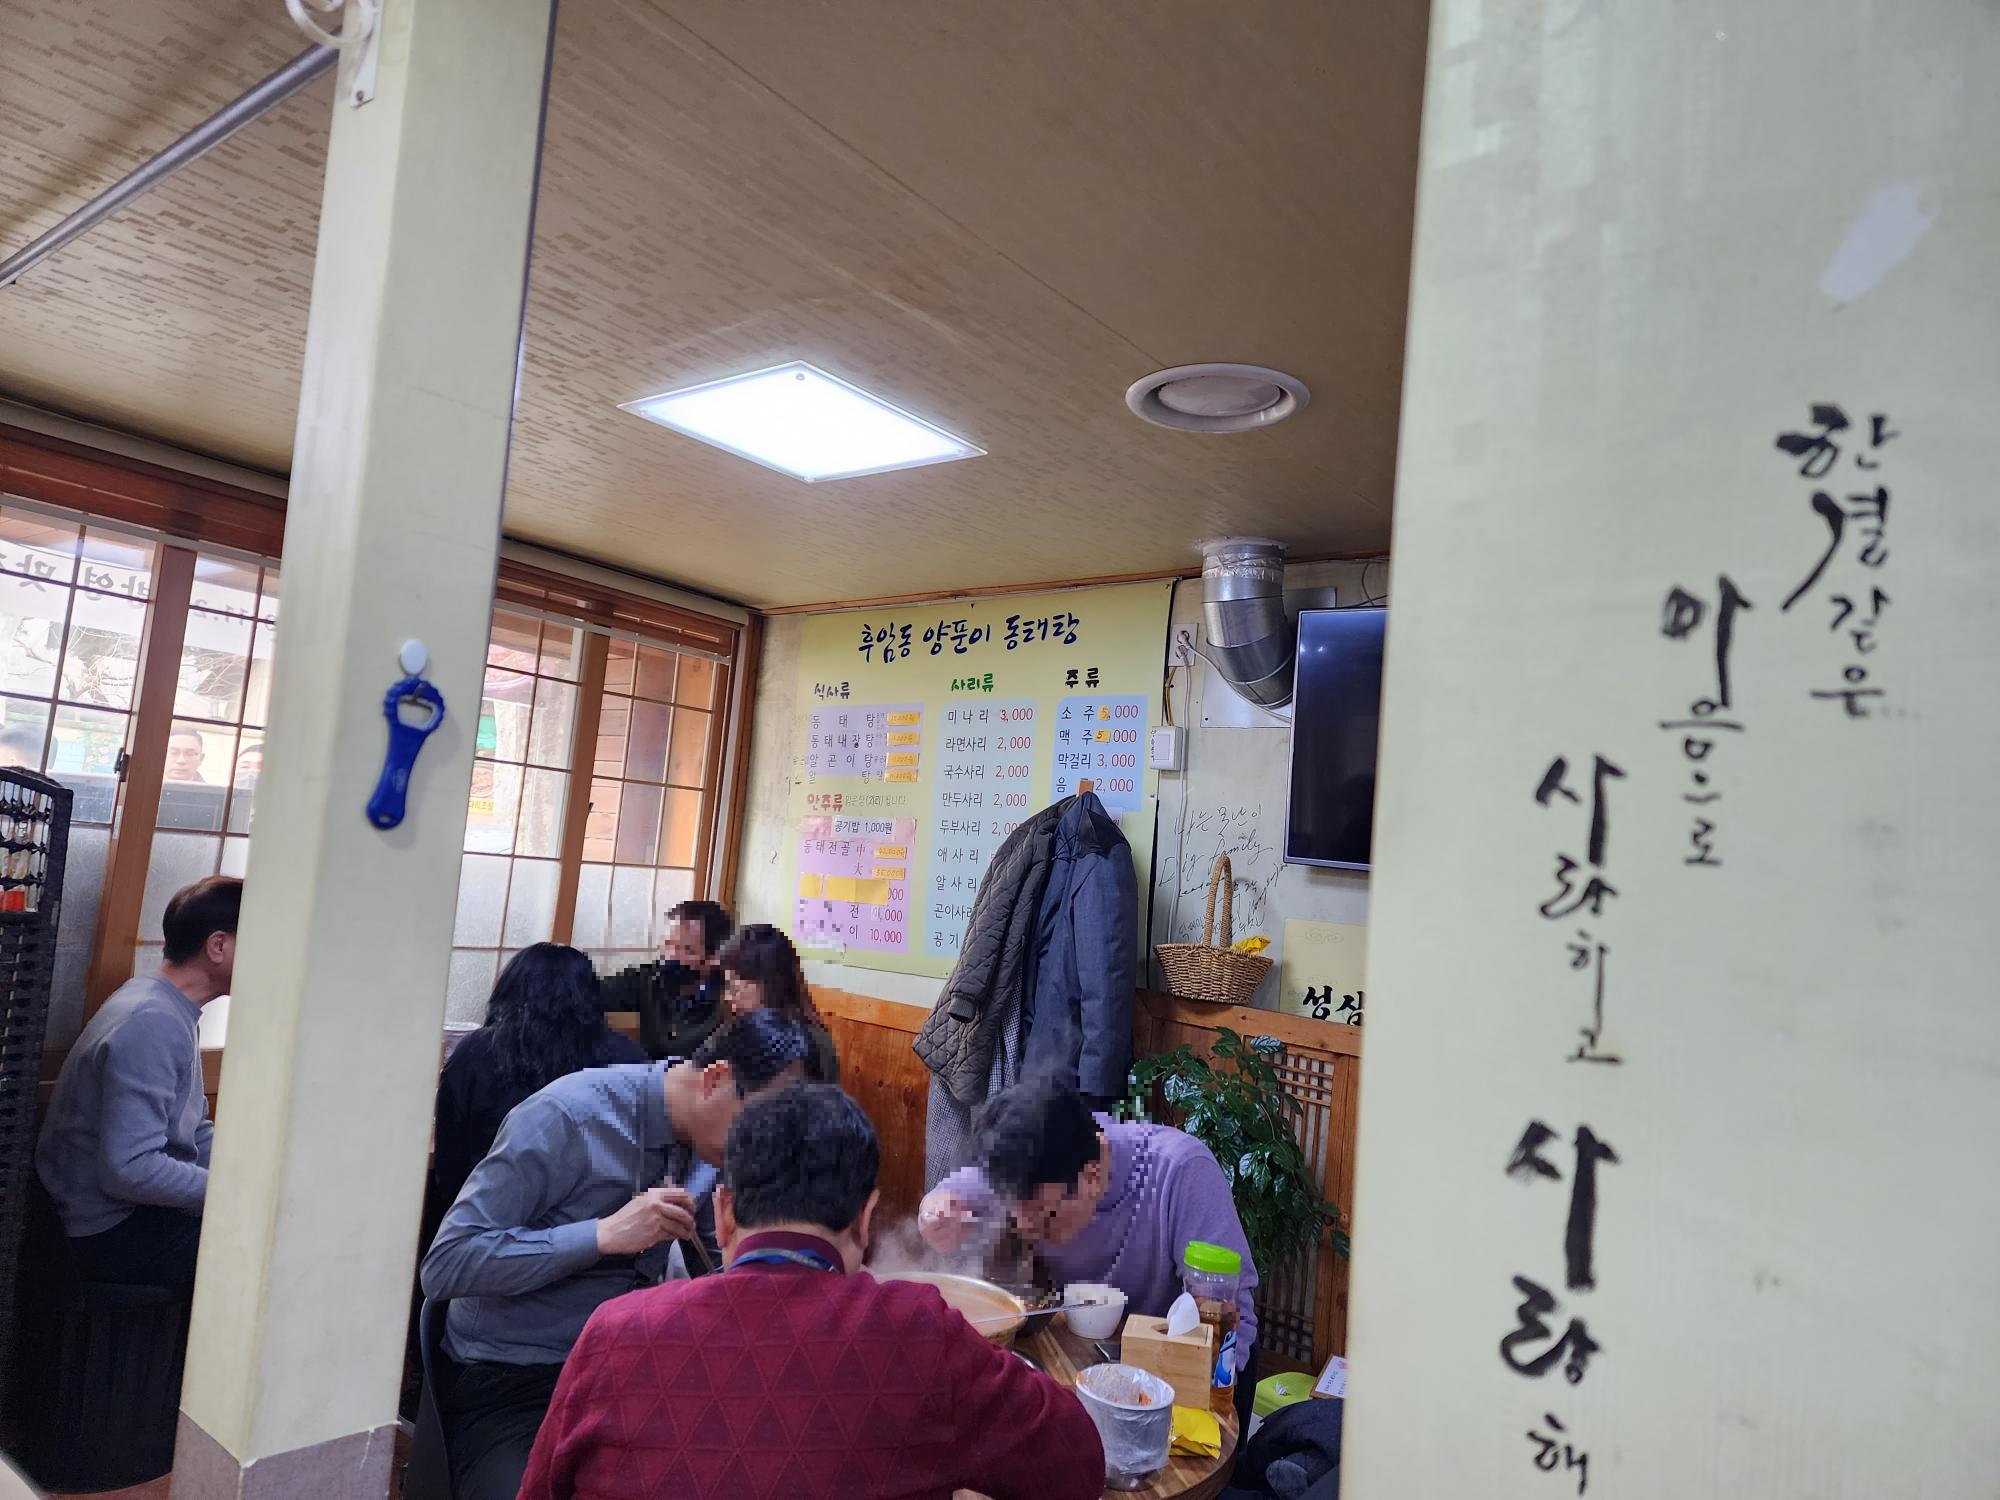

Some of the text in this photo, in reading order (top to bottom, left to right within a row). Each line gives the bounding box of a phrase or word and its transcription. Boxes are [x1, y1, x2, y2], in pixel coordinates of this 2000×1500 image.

[1776, 404, 1899, 718] 한결같은
[858, 612, 1080, 663] 후암동 양푼이 동태탕
[951, 673, 994, 692] 사리류
[1065, 667, 1100, 688] 주류
[814, 681, 850, 701] 식사류
[1000, 707, 1033, 722] 3,000
[1658, 573, 1753, 867] 마음으로
[945, 736, 1031, 752] 라면사리 2,000
[1058, 753, 1136, 769] 막걸리 3,000
[944, 764, 1029, 780] 국수사리 2,000
[1095, 778, 1134, 793] 2,000
[807, 793, 842, 812] 안주류
[942, 791, 1027, 808] 만두사리 2,000
[834, 820, 893, 835] 공기밥 1,000원
[939, 819, 1022, 837] 두부사리 2,00
[803, 841, 850, 857] 동태전골
[870, 928, 902, 944] 10,000
